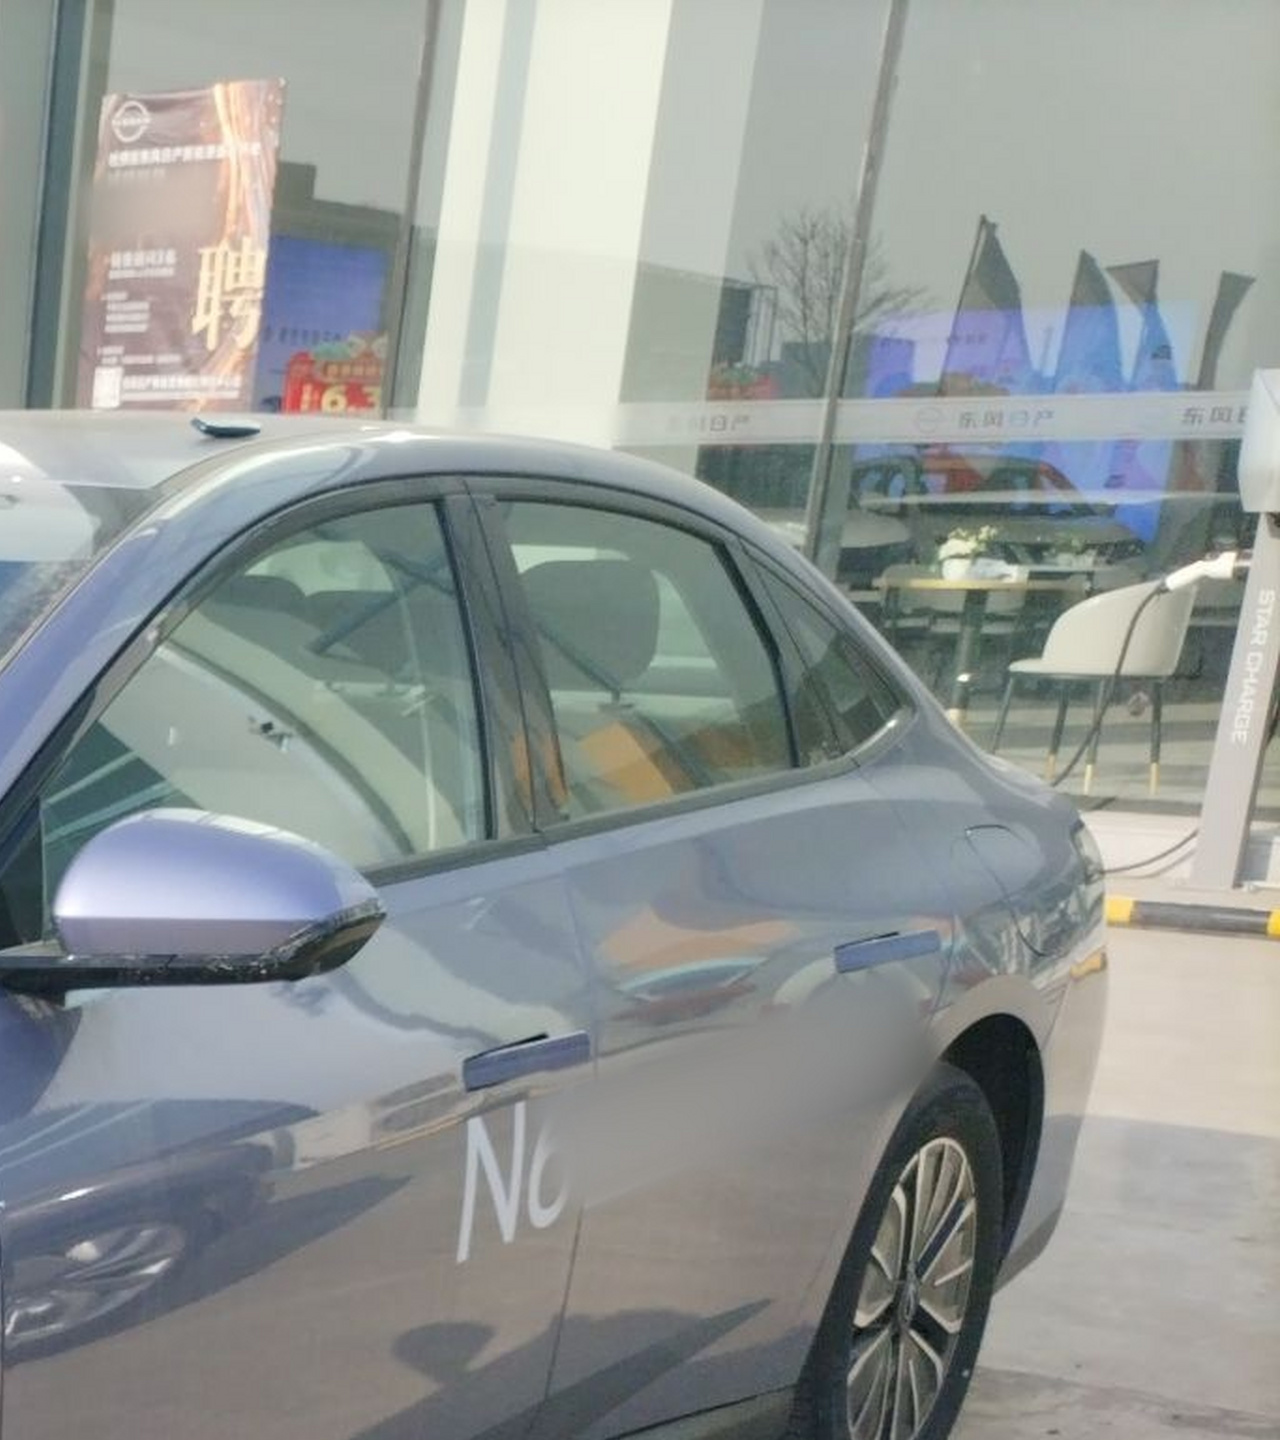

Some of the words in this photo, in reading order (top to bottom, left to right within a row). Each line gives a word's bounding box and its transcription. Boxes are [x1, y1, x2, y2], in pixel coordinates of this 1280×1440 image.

[192, 236, 268, 350] 聘
[958, 409, 1055, 429] 东风日产
[1250, 589, 1275, 646] STAR
[1231, 650, 1263, 744] CHARGE
